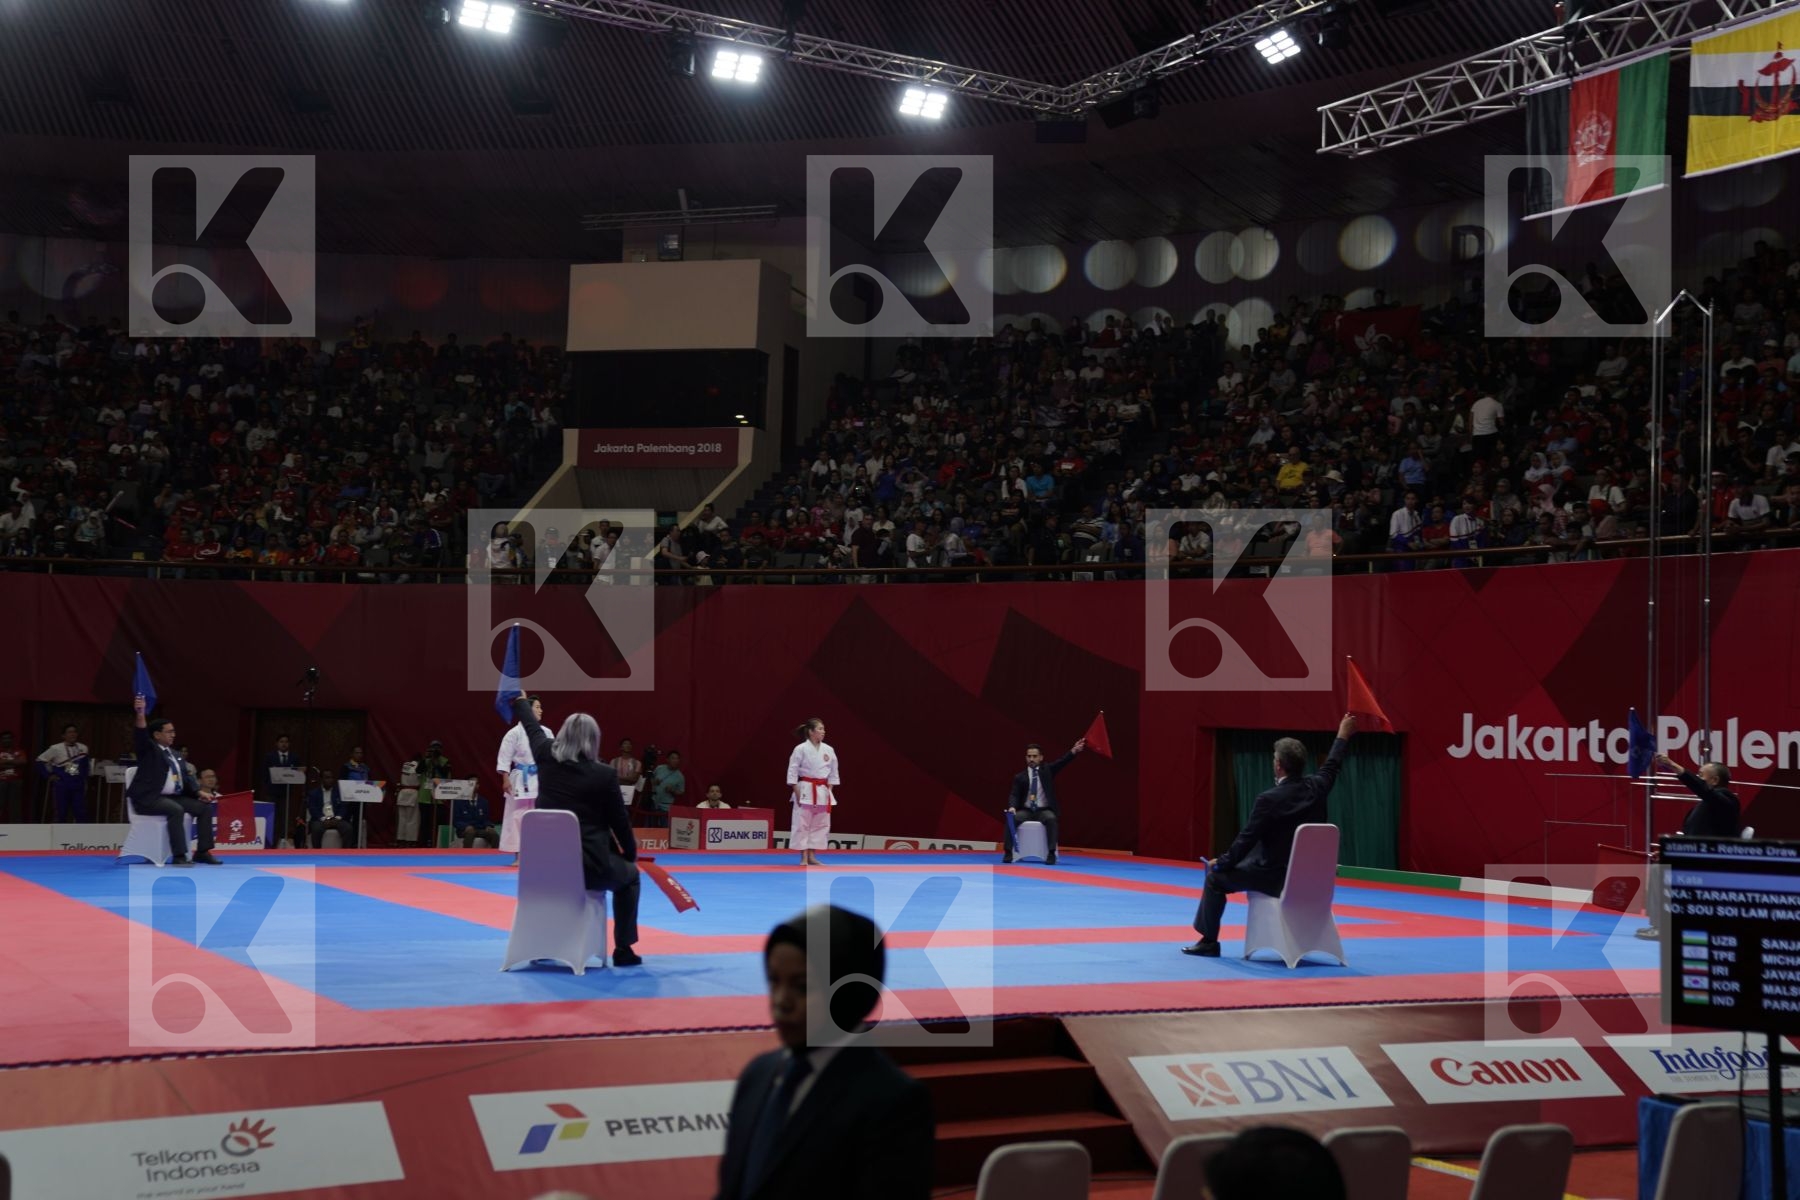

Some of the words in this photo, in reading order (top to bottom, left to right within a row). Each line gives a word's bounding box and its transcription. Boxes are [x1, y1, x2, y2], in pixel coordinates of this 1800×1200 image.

[594, 443, 634, 453] Jakarta
[636, 443, 695, 455] Palembang
[697, 443, 722, 453] 2018
[723, 831, 750, 840] BANK
[752, 831, 767, 840] BRI
[1700, 843, 1708, 852] 2
[1718, 844, 1763, 855] Referee
[1766, 846, 1797, 857] Draw
[1687, 904, 1713, 915] SOU
[1716, 906, 1738, 917] SOI
[1742, 907, 1768, 918] LAM
[1712, 936, 1737, 947] UZB
[1712, 950, 1736, 962] TPE
[1712, 965, 1729, 976] IRI
[1712, 981, 1740, 992] KOR
[1712, 995, 1735, 1007] IND
[1430, 1056, 1582, 1087] Canon
[1226, 1056, 1360, 1104] BNI
[604, 1112, 732, 1137] PERTAMI
[131, 1149, 217, 1167] Telkom
[146, 1161, 260, 1182] Indonesia
